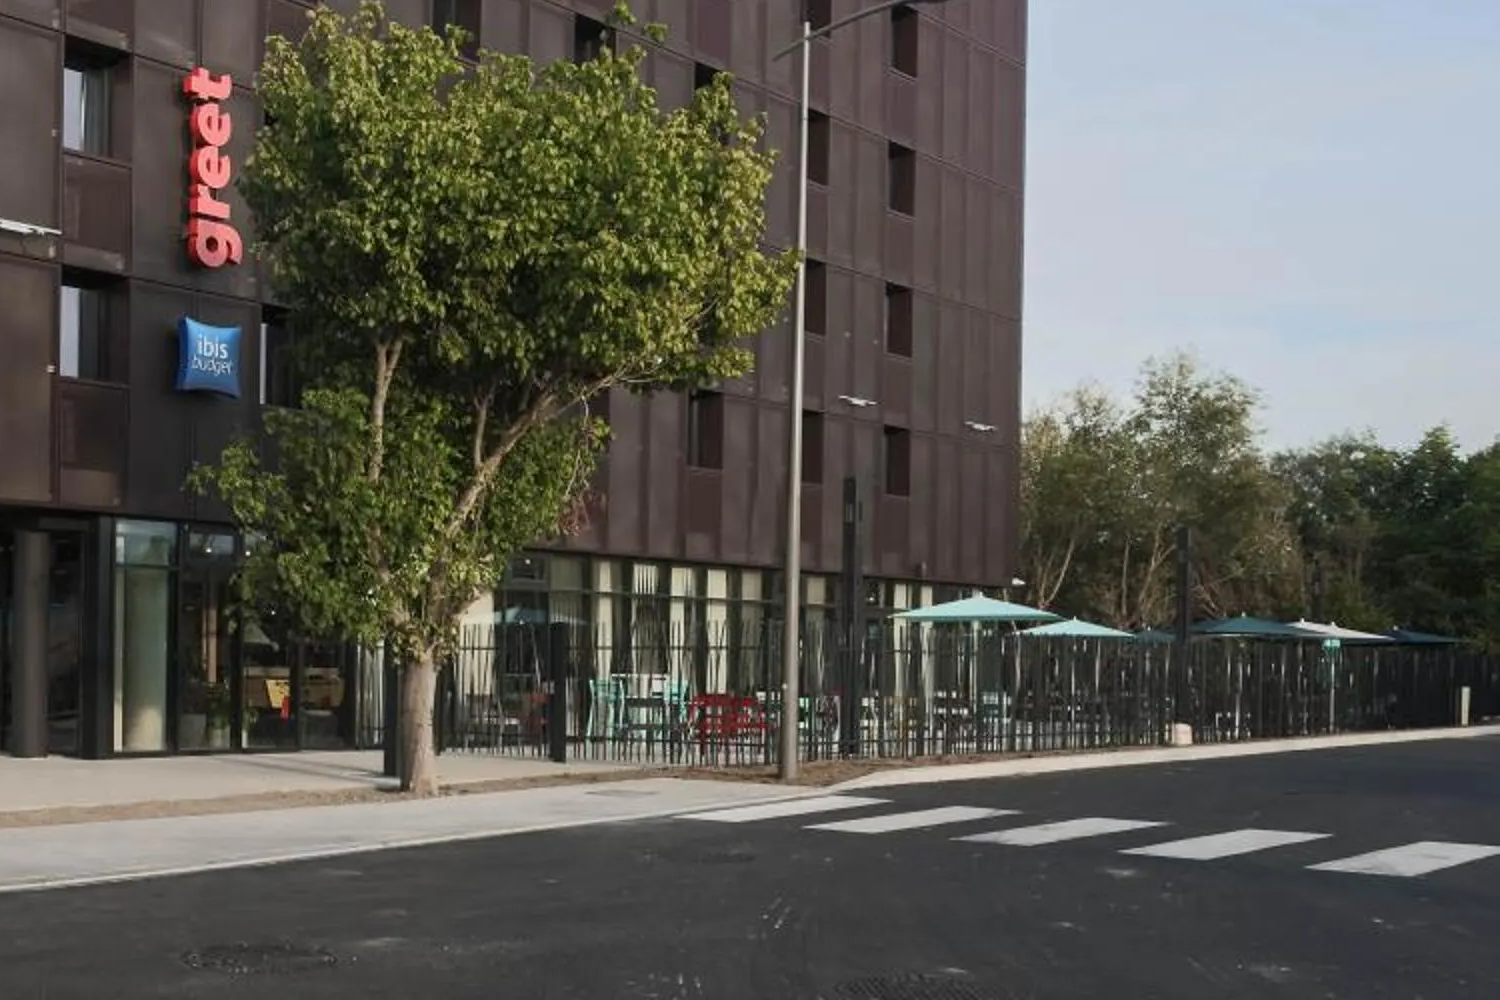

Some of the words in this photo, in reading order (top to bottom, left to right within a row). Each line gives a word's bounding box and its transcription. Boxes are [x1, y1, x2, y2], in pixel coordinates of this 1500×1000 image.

[183, 66, 243, 268] greet
[196, 333, 229, 359] ibis
[190, 353, 234, 377] budget
